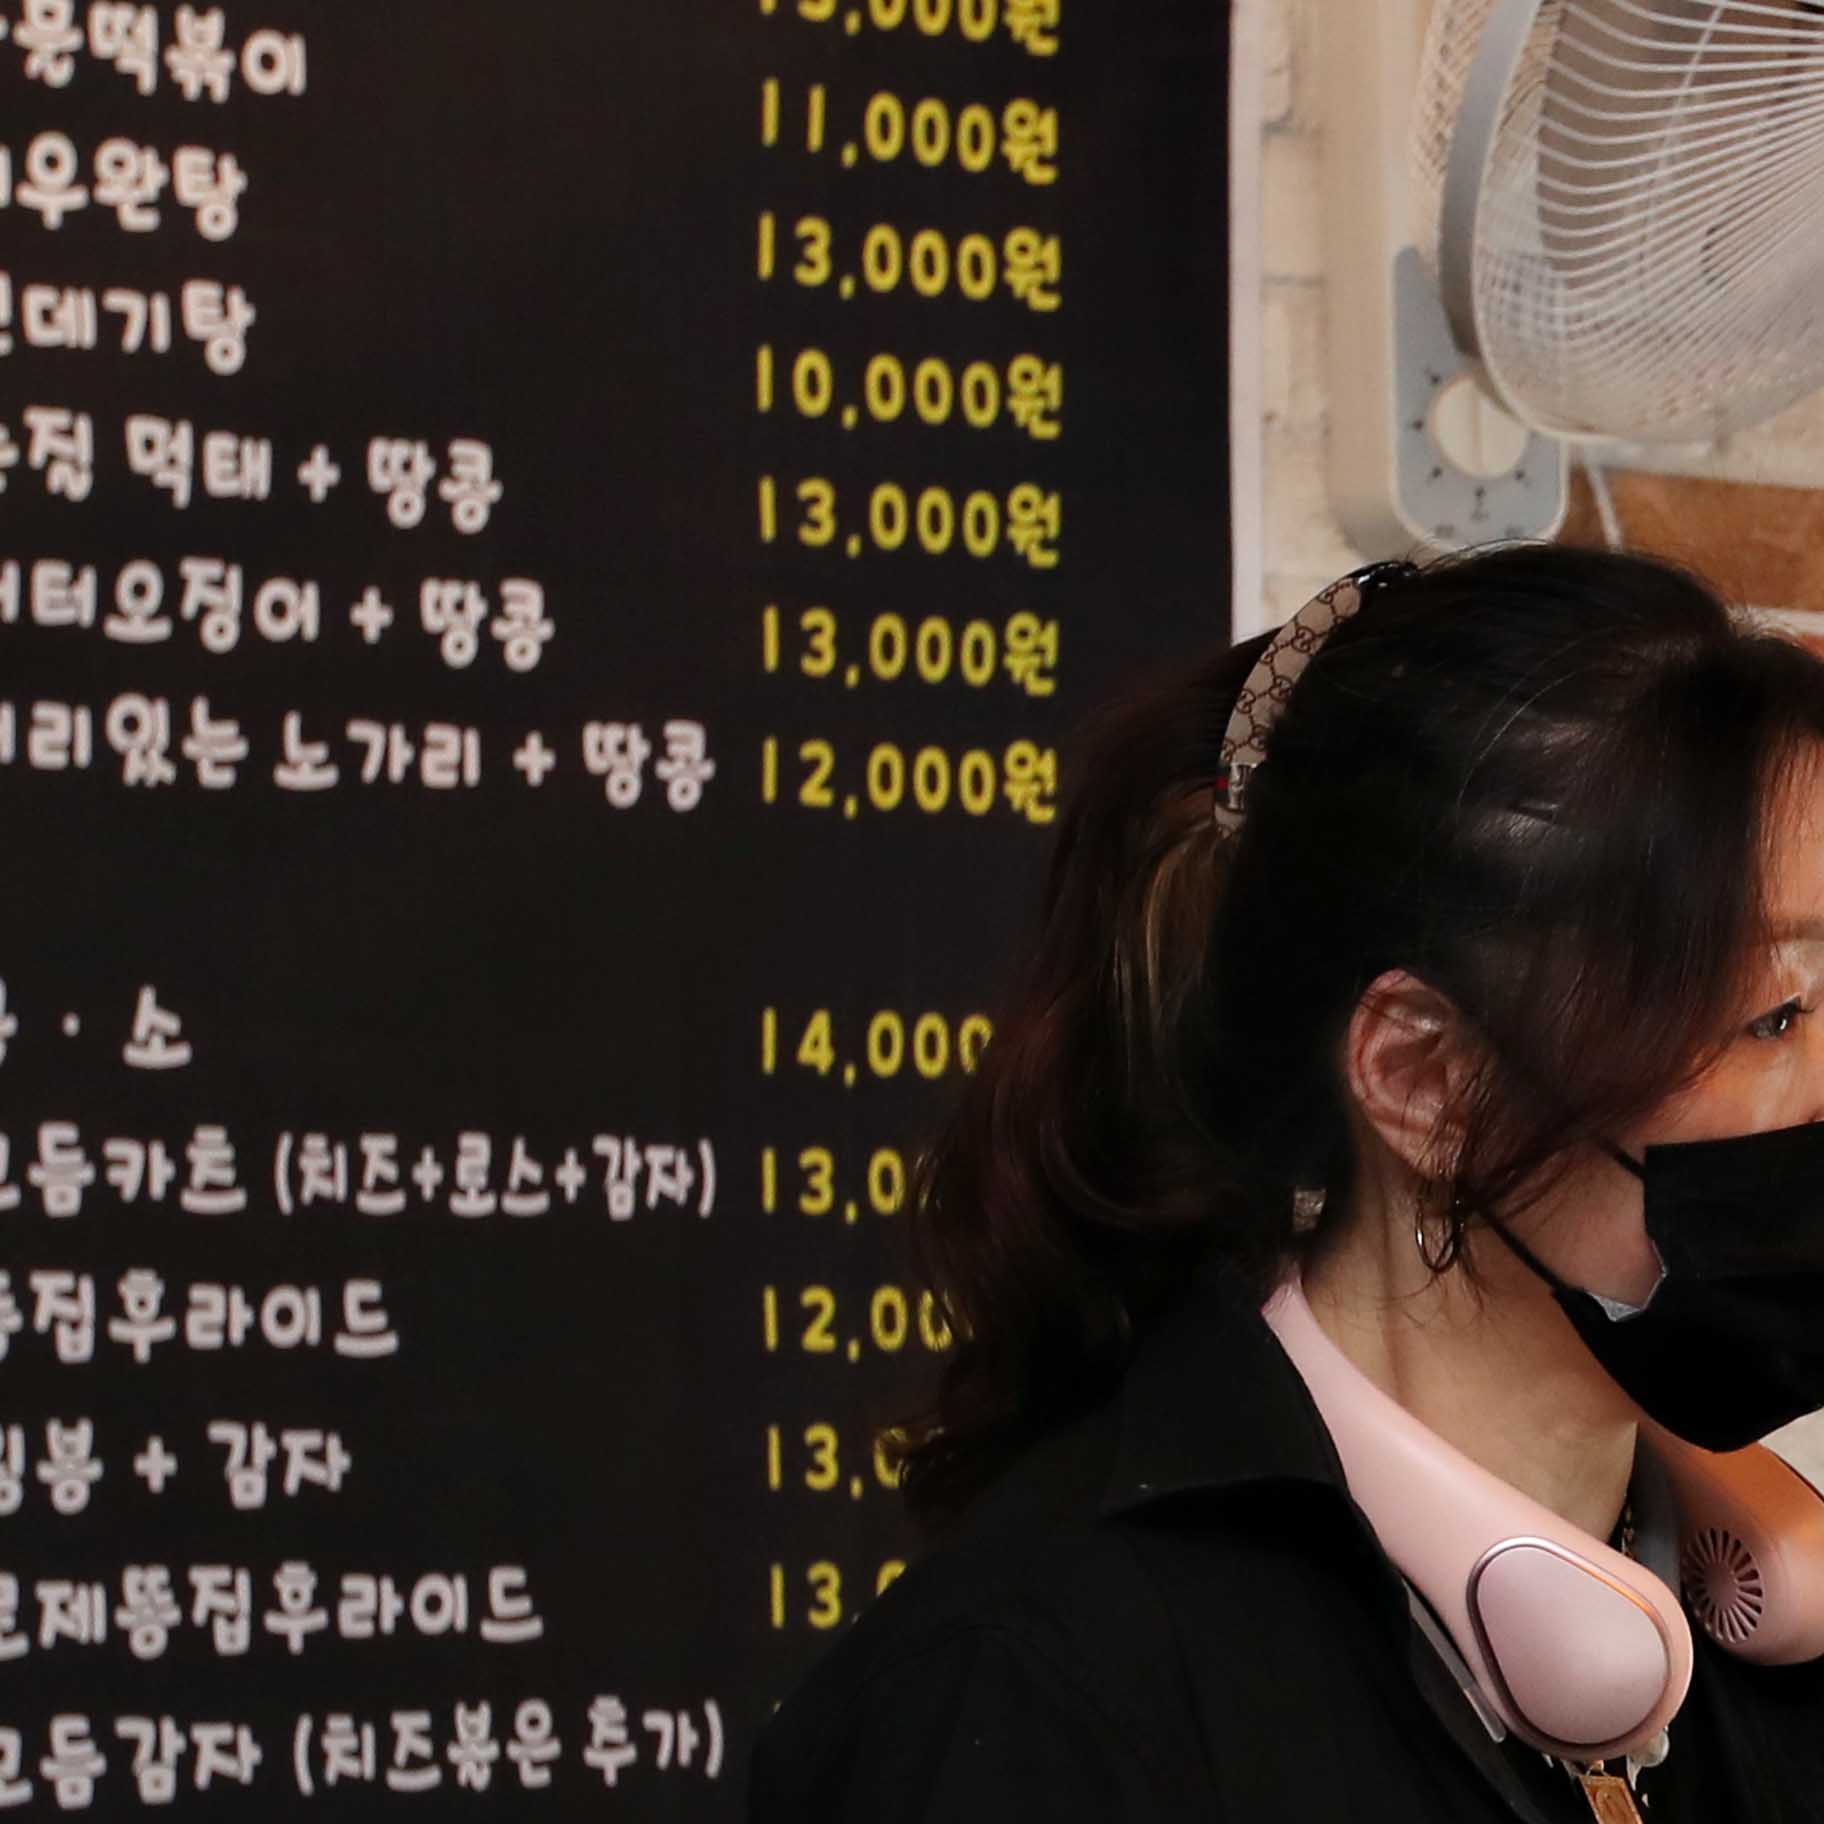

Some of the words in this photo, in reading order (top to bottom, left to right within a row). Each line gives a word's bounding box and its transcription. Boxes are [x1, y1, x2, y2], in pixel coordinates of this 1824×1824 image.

[0, 0, 306, 103] 물떡볶이
[763, 80, 1057, 184] 11,000원
[0, 132, 247, 241] 우완탕
[758, 213, 1060, 310] 13,000원
[0, 271, 255, 375] 데기탕
[757, 346, 1061, 439] 10,000원
[0, 406, 93, 501] 질
[125, 415, 271, 508] 먹태
[367, 437, 502, 534] 땅콩
[759, 477, 1059, 567] 13,000원
[0, 557, 319, 652] 터오징어
[420, 578, 554, 671] 땅콩
[763, 606, 1057, 695] 13,000원
[0, 693, 248, 788] 리있는
[274, 712, 480, 790] 노가리
[583, 720, 715, 811] 땅콩
[763, 738, 1056, 823] 12,000원
[275, 1132, 715, 1220] (치즈+로스+감자)
[208, 1422, 350, 1508] 감자
[584, 1696, 723, 1786] 추가)
